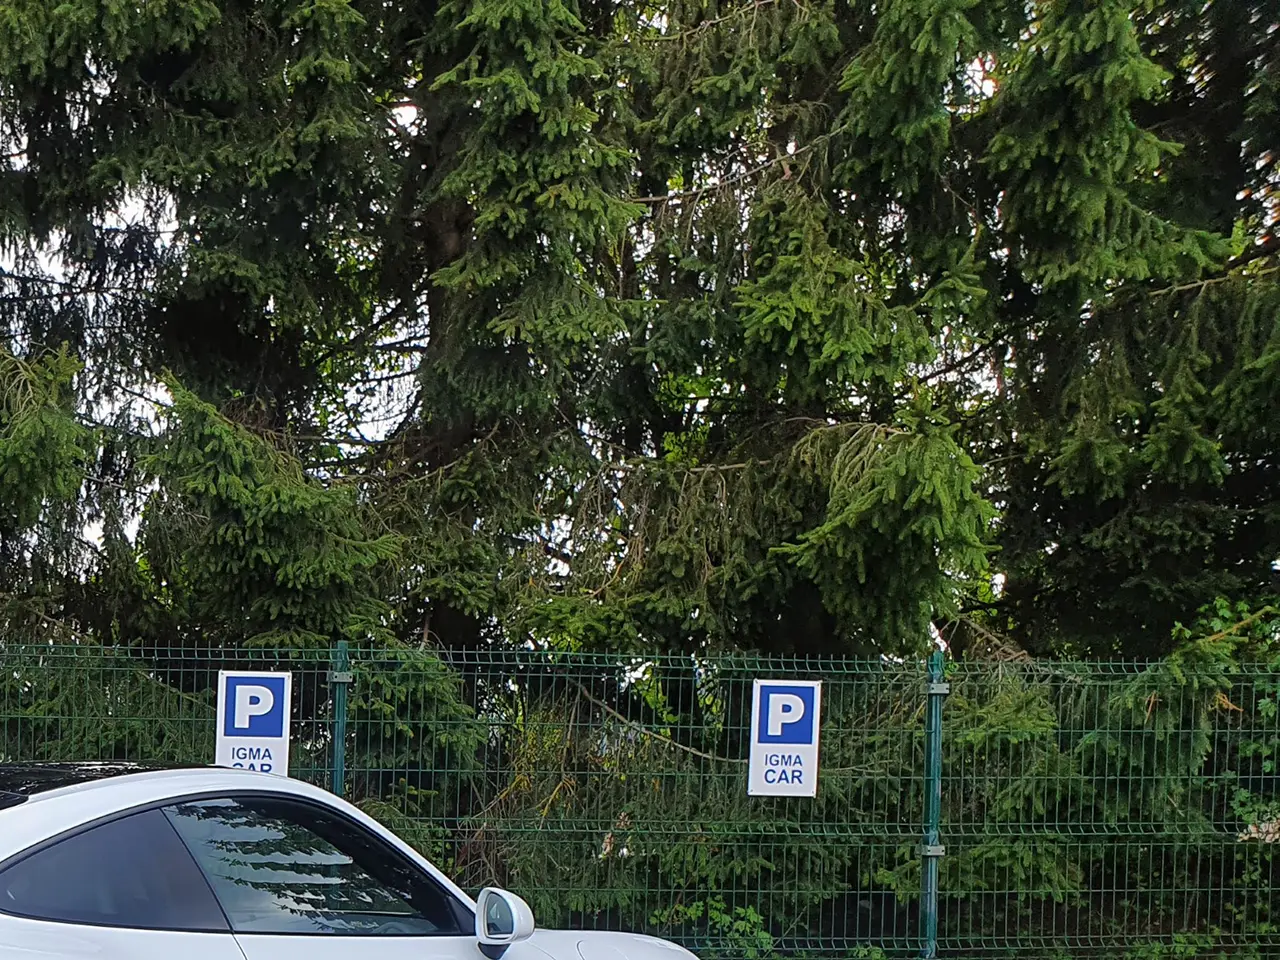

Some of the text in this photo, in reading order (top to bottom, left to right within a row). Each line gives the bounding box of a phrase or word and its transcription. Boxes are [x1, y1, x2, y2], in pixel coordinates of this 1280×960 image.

[234, 685, 274, 728] P
[767, 693, 805, 735] P
[231, 747, 272, 760] IGMA
[764, 754, 803, 767] IGMA
[764, 769, 803, 784] CAR
